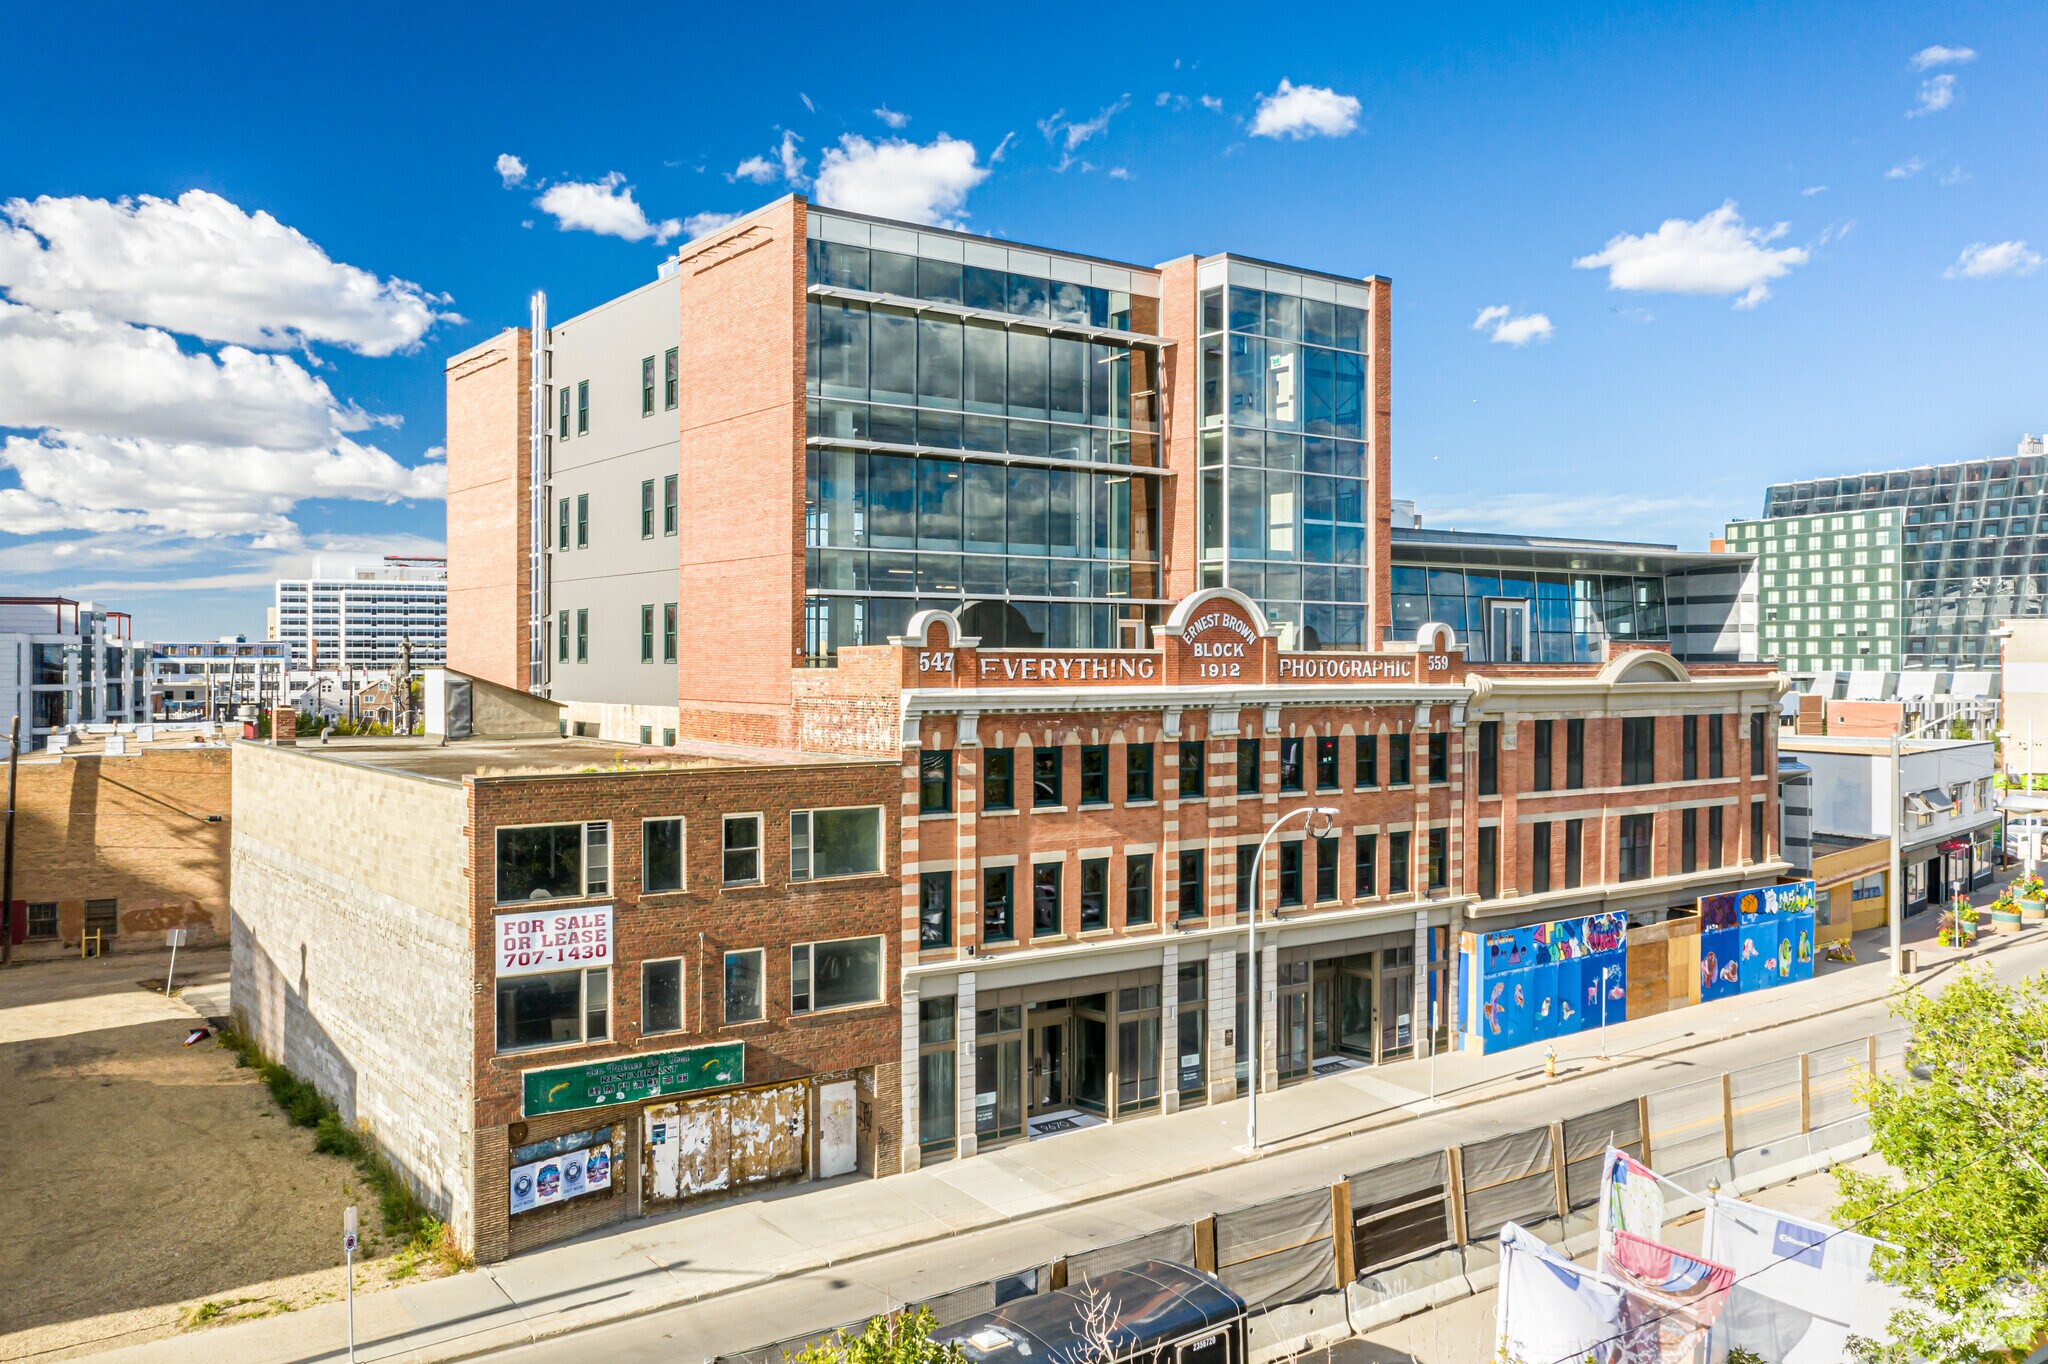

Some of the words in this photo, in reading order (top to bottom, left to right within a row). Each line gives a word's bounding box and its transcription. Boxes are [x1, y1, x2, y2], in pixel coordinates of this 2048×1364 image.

[1182, 613, 1220, 646] ERNEST
[1222, 613, 1257, 646] BROWN
[1194, 643, 1244, 658] BLOCK
[919, 652, 954, 673] 547
[980, 657, 1154, 681] EVERYTHING
[1200, 662, 1240, 678] 1912
[1279, 658, 1411, 678] PHOTOGRAPHIC
[1428, 655, 1449, 671] 559
[503, 919, 544, 936] FOR
[554, 913, 606, 931] SALE
[503, 936, 531, 951] OR
[541, 929, 607, 948] LEASE
[503, 943, 607, 968] 707-1430
[586, 1066, 605, 1077] Sea
[606, 1061, 642, 1073] Palace
[600, 1064, 678, 1084] RESTAURANT
[1040, 1121, 1070, 1131] 9670
